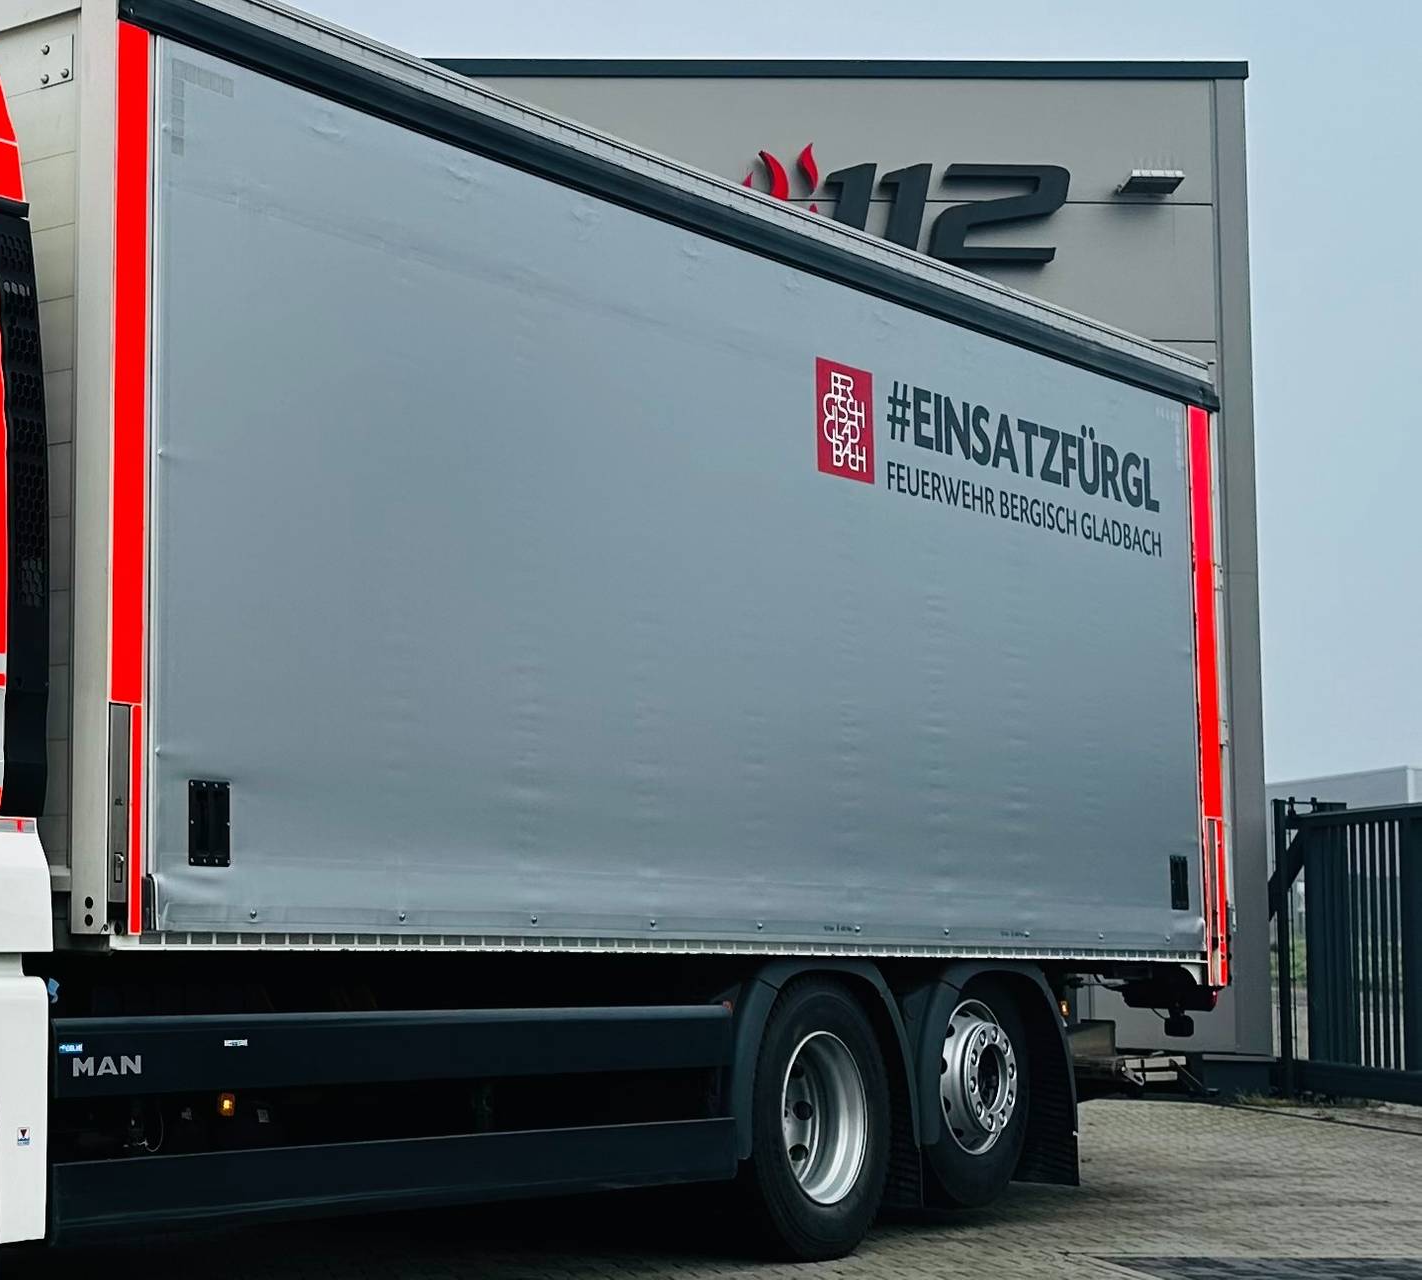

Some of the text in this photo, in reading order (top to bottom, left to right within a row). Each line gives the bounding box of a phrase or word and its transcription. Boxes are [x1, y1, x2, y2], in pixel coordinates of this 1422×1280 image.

[824, 163, 1067, 263] 112
[886, 381, 1159, 513] #EINSATZFÜRGL
[887, 461, 1163, 558] FEUERWEHR BERGISCH GLADBACH
[72, 1054, 142, 1077] MAN
